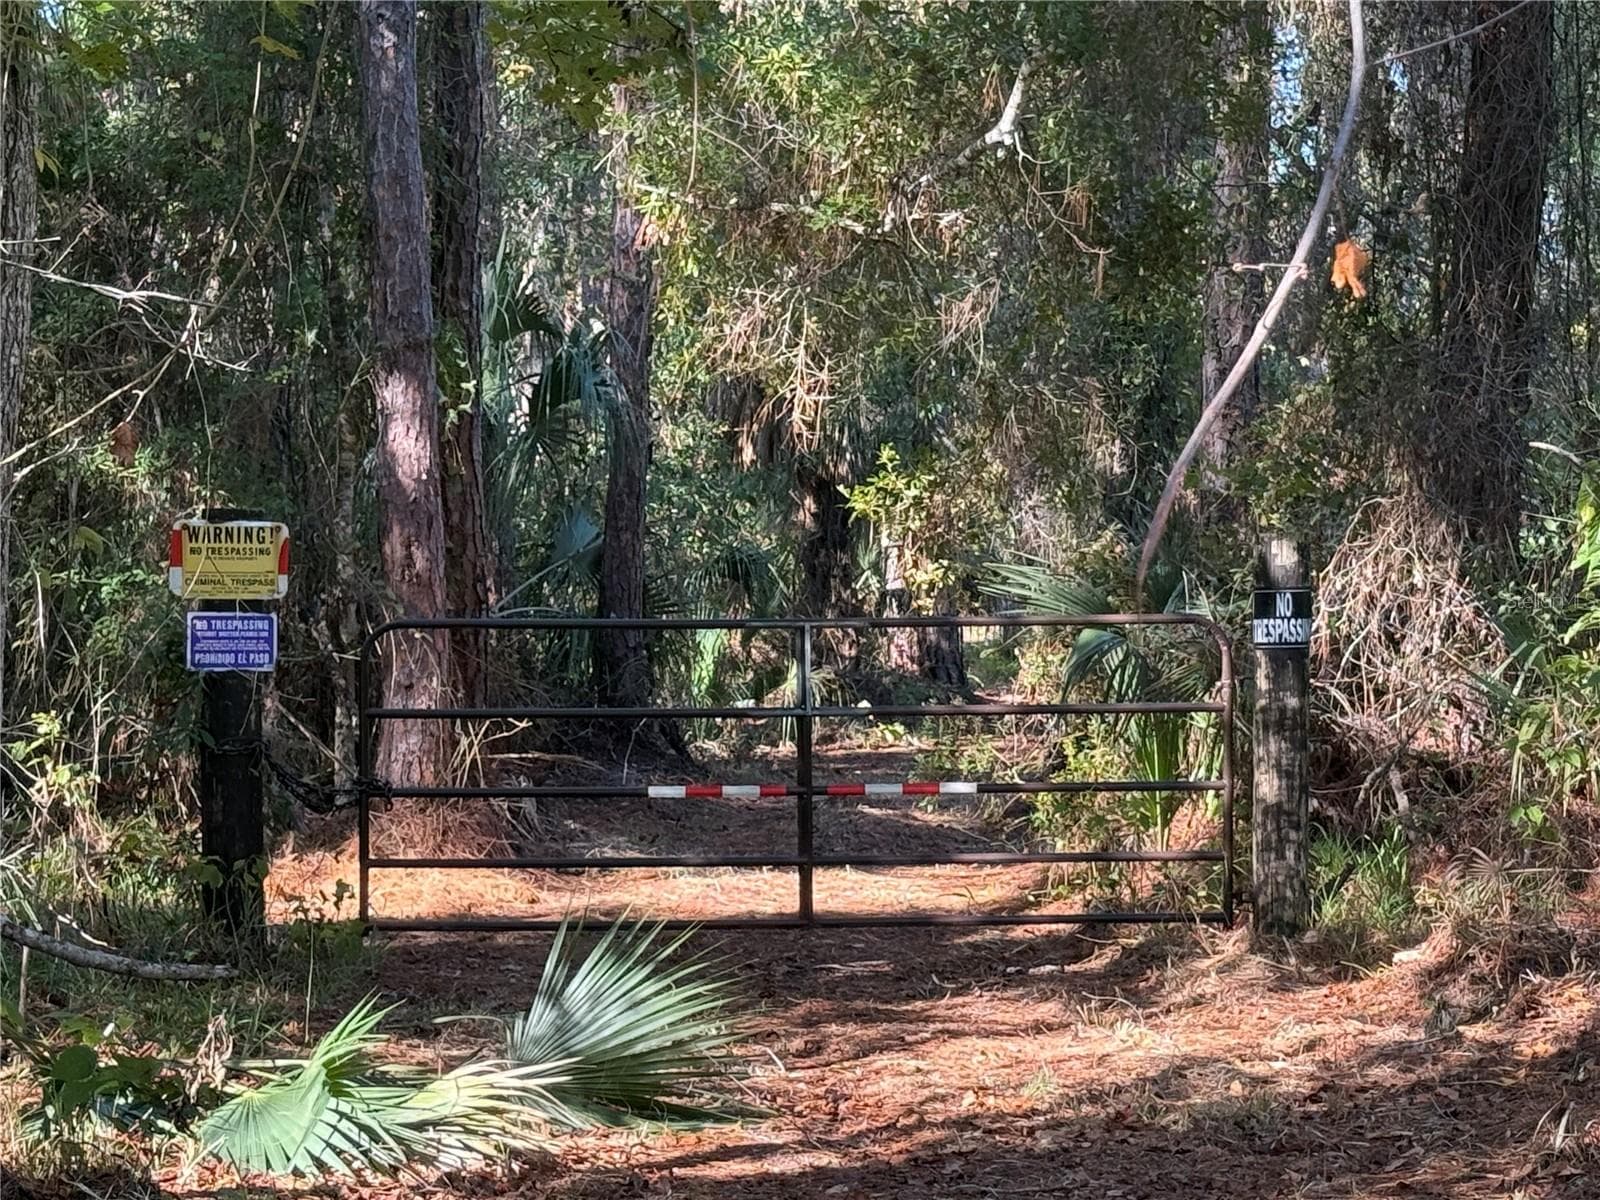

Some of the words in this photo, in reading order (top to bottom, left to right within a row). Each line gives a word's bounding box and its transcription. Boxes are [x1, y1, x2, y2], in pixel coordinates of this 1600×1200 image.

[187, 526, 274, 544] WARNING!
[189, 547, 202, 556] NO
[206, 546, 271, 556] TRESPASSING
[231, 577, 275, 586] TRESPASS
[1275, 592, 1293, 617] NO
[210, 619, 269, 630] TRESPASSING
[238, 652, 247, 664] EL
[249, 652, 270, 664] PASO
